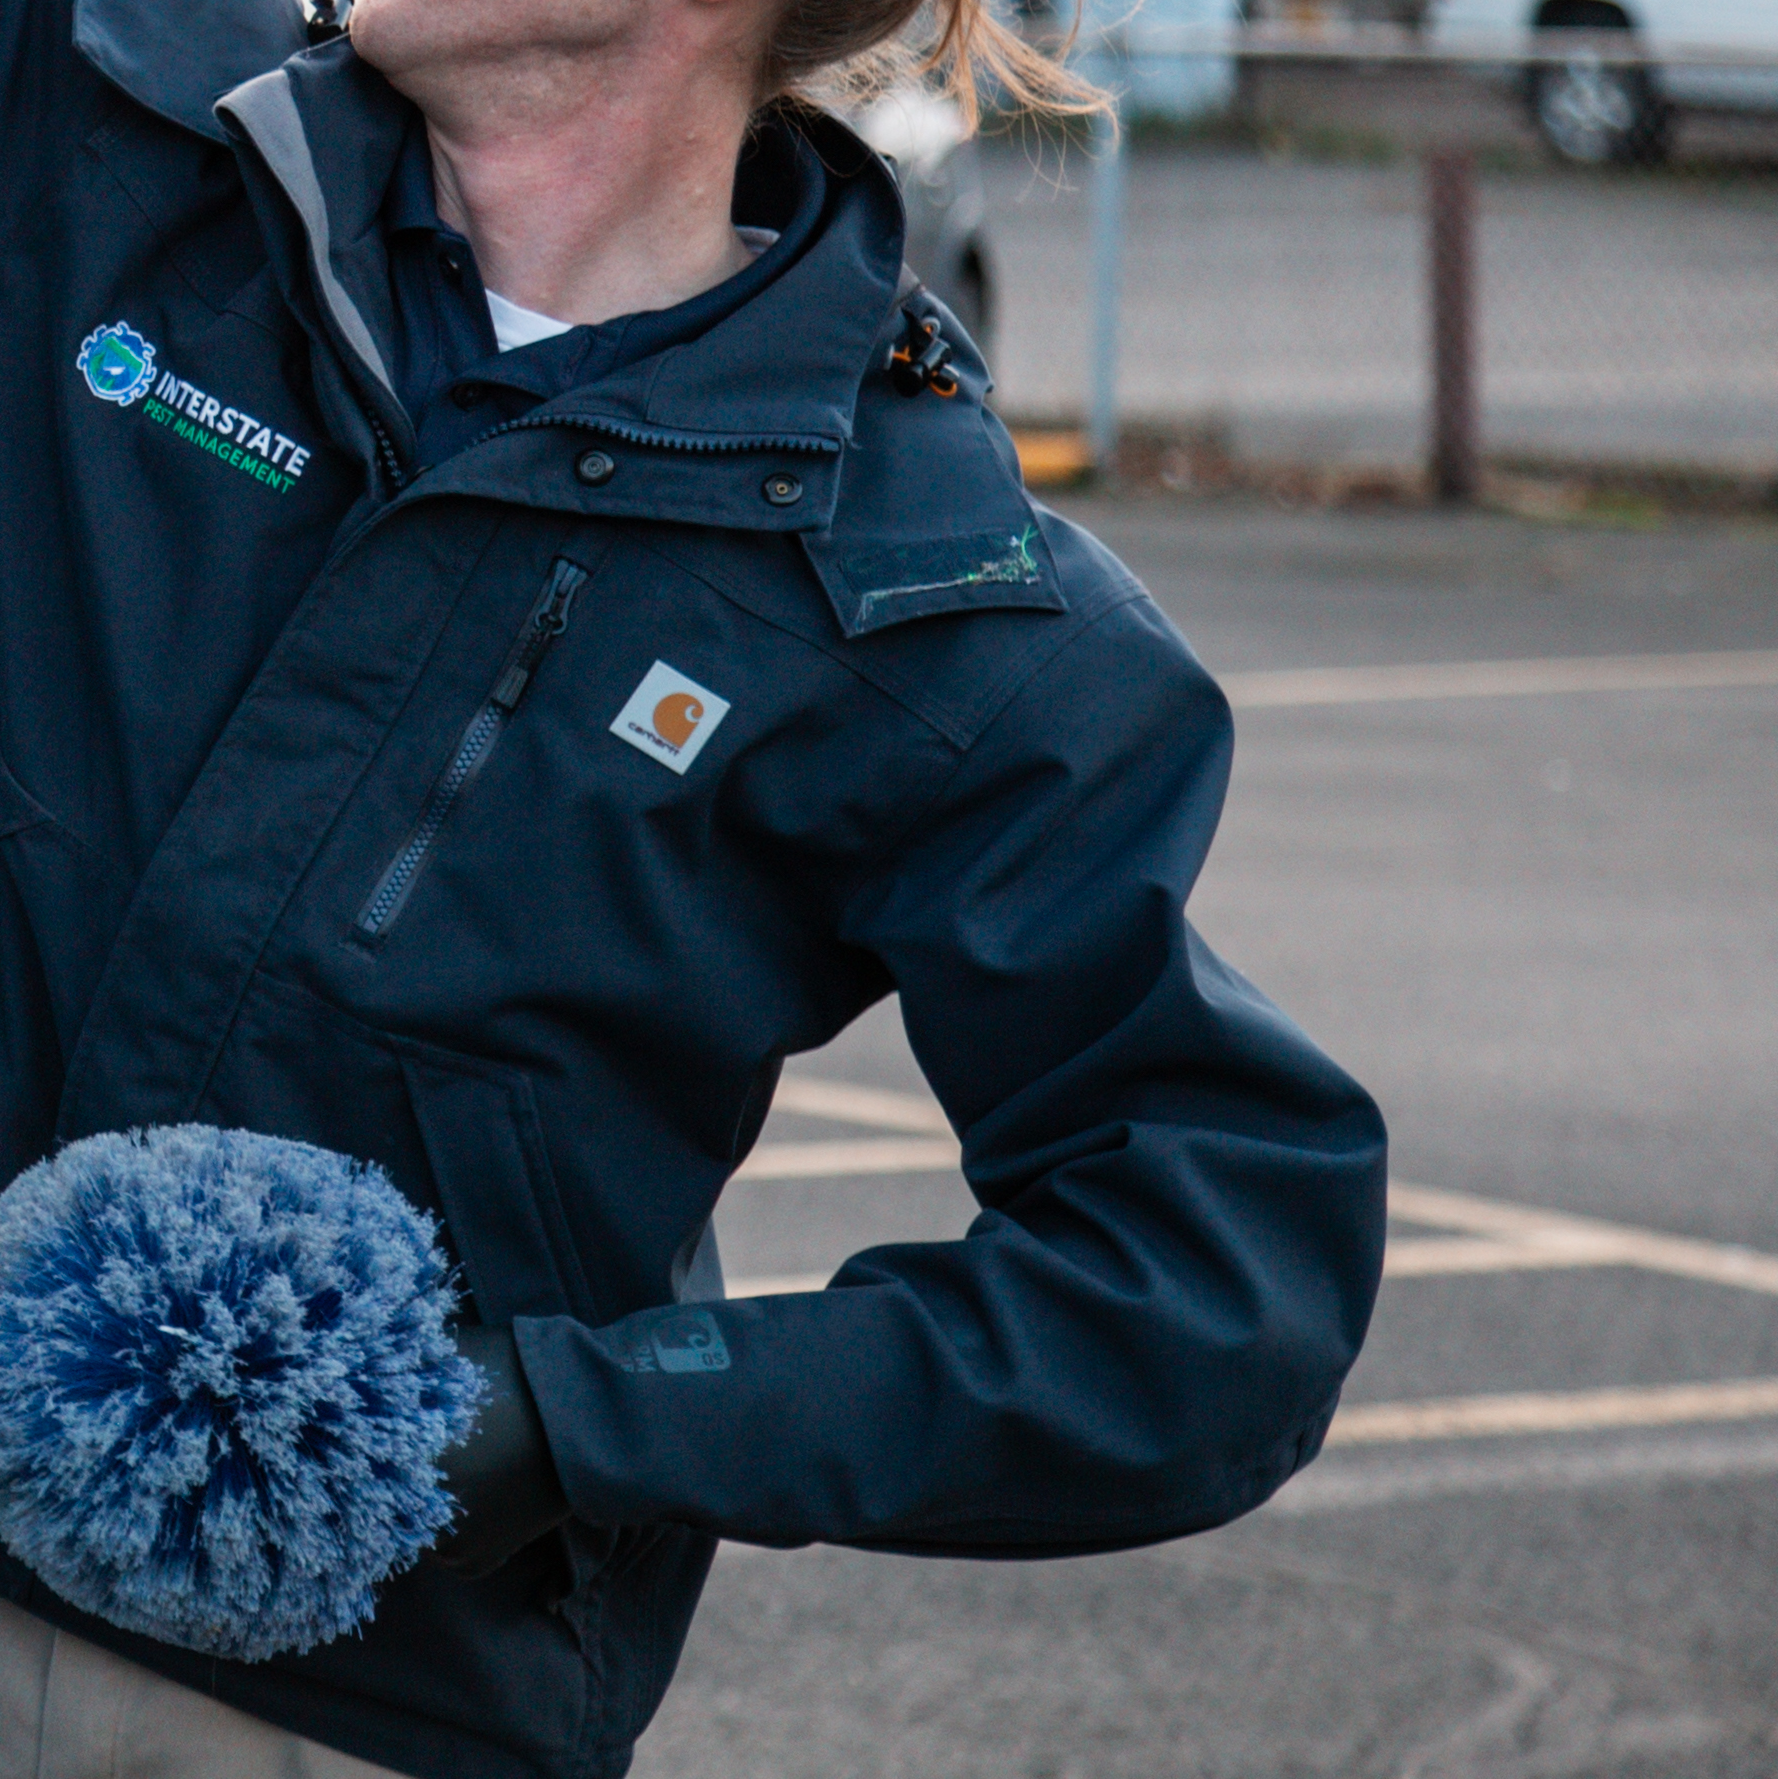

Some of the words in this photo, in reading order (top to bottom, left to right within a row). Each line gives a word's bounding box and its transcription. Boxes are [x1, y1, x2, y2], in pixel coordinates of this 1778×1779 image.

[143, 397, 175, 427] PEST
[173, 418, 296, 495] MANAGEMENT
[154, 371, 311, 477] INTERSTATE
[628, 722, 680, 757] carhartt
